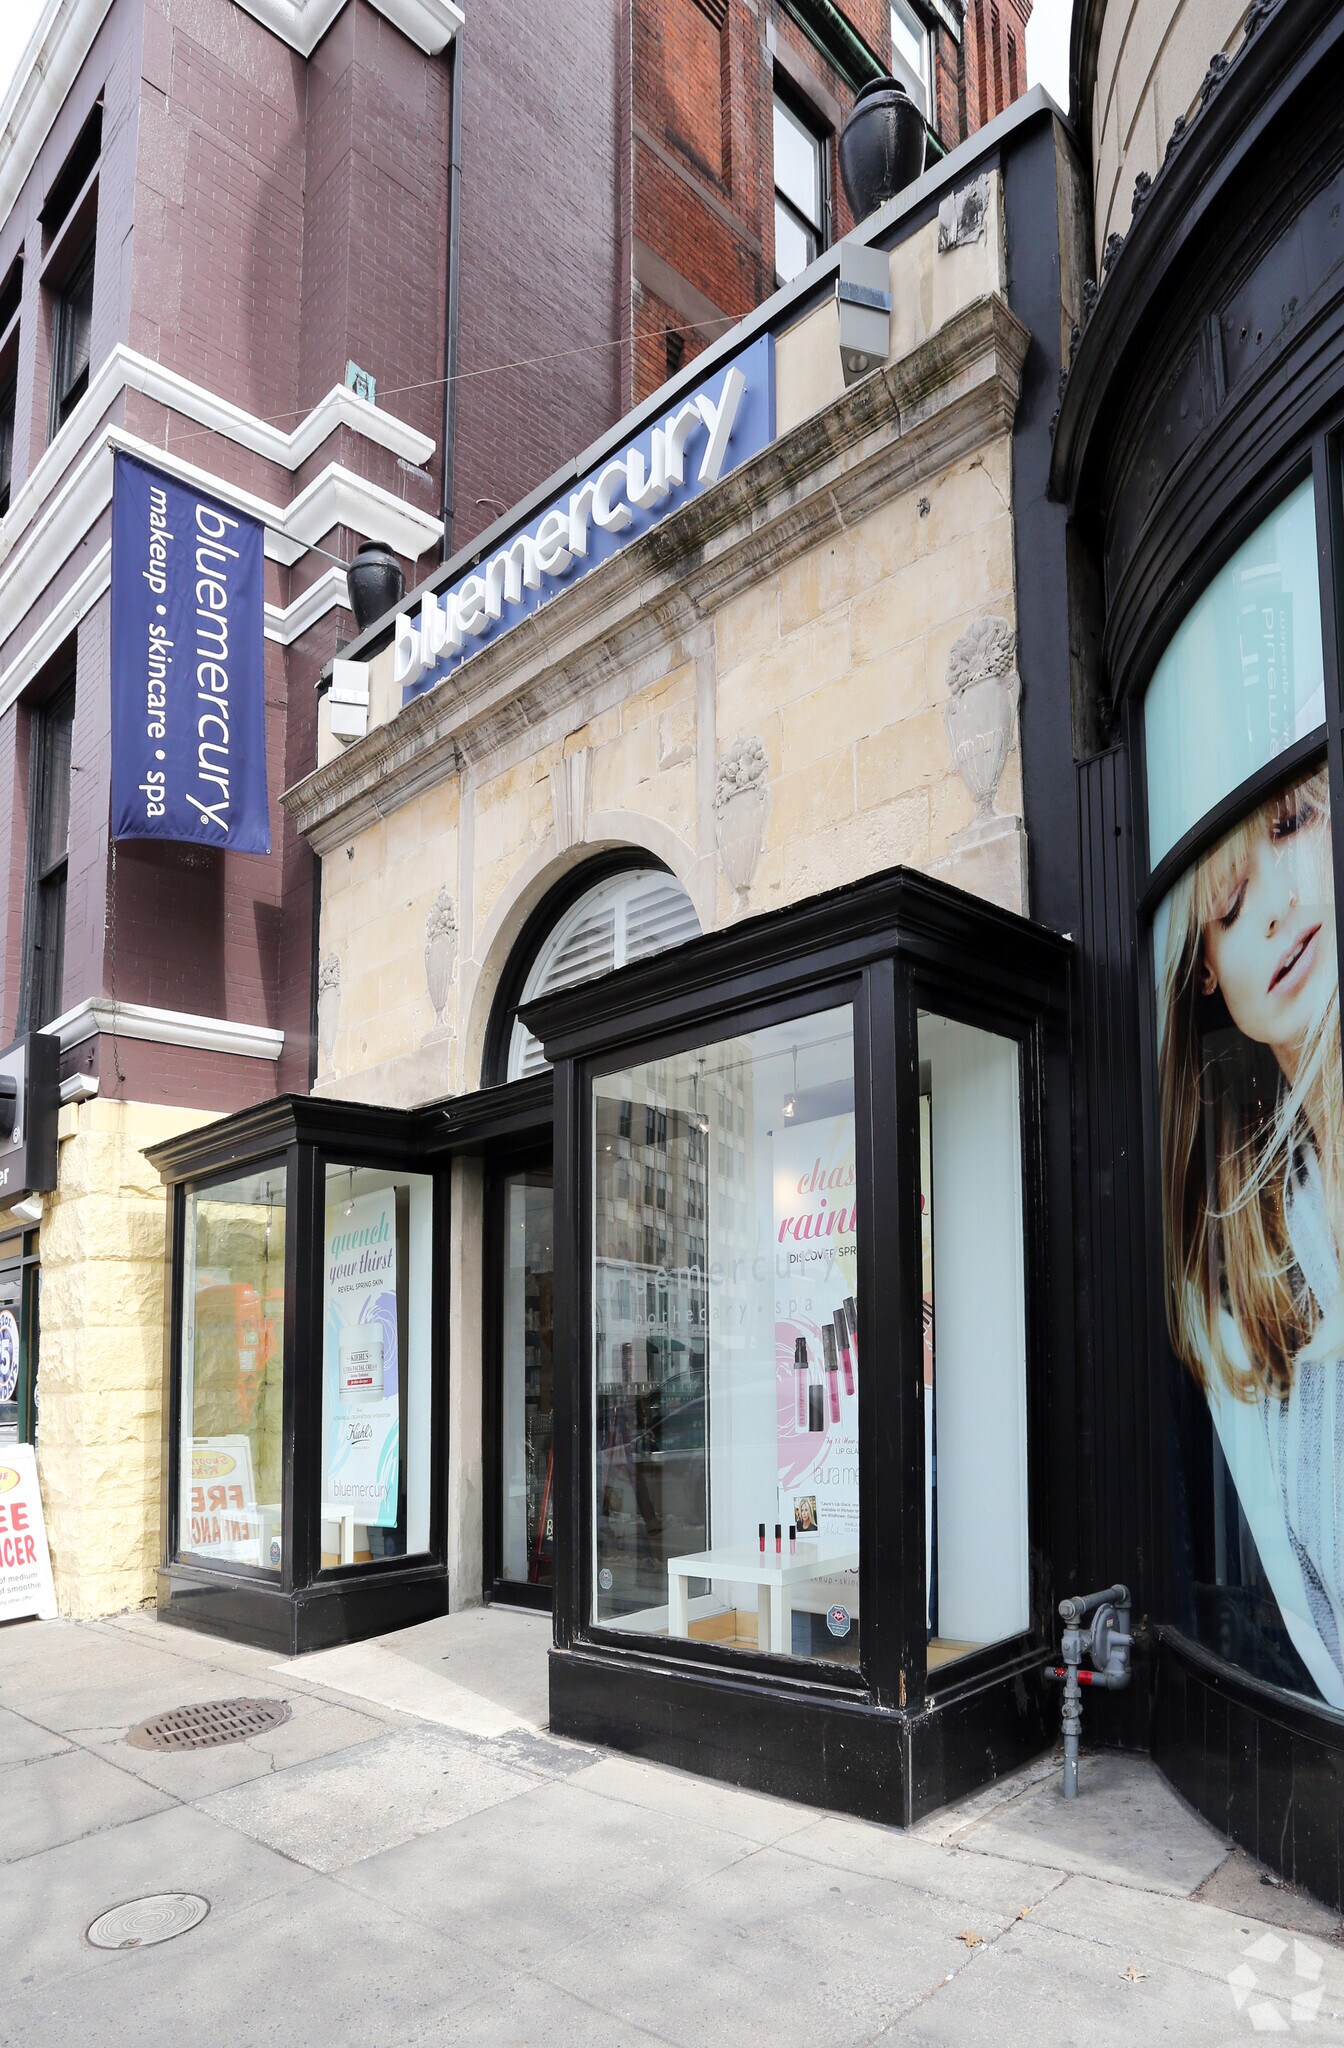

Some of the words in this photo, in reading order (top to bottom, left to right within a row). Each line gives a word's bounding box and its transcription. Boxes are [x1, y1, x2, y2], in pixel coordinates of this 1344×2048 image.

[142, 485, 175, 595] makeup
[393, 366, 746, 688] bluemercury
[146, 622, 173, 740] skincare
[138, 769, 168, 819] spa
[331, 1210, 390, 1261] quench
[329, 1260, 357, 1287] your
[359, 1247, 394, 1275] thirst
[338, 1283, 354, 1294] REVEAL
[355, 1280, 372, 1291] SPRING
[372, 1278, 384, 1288] SKIN
[776, 1298, 813, 1319] spa
[835, 1447, 845, 1455] LIP
[333, 1479, 391, 1502] bluemercury
[7, 1581, 42, 1594] smoothie
[8, 1571, 38, 1583] medium
